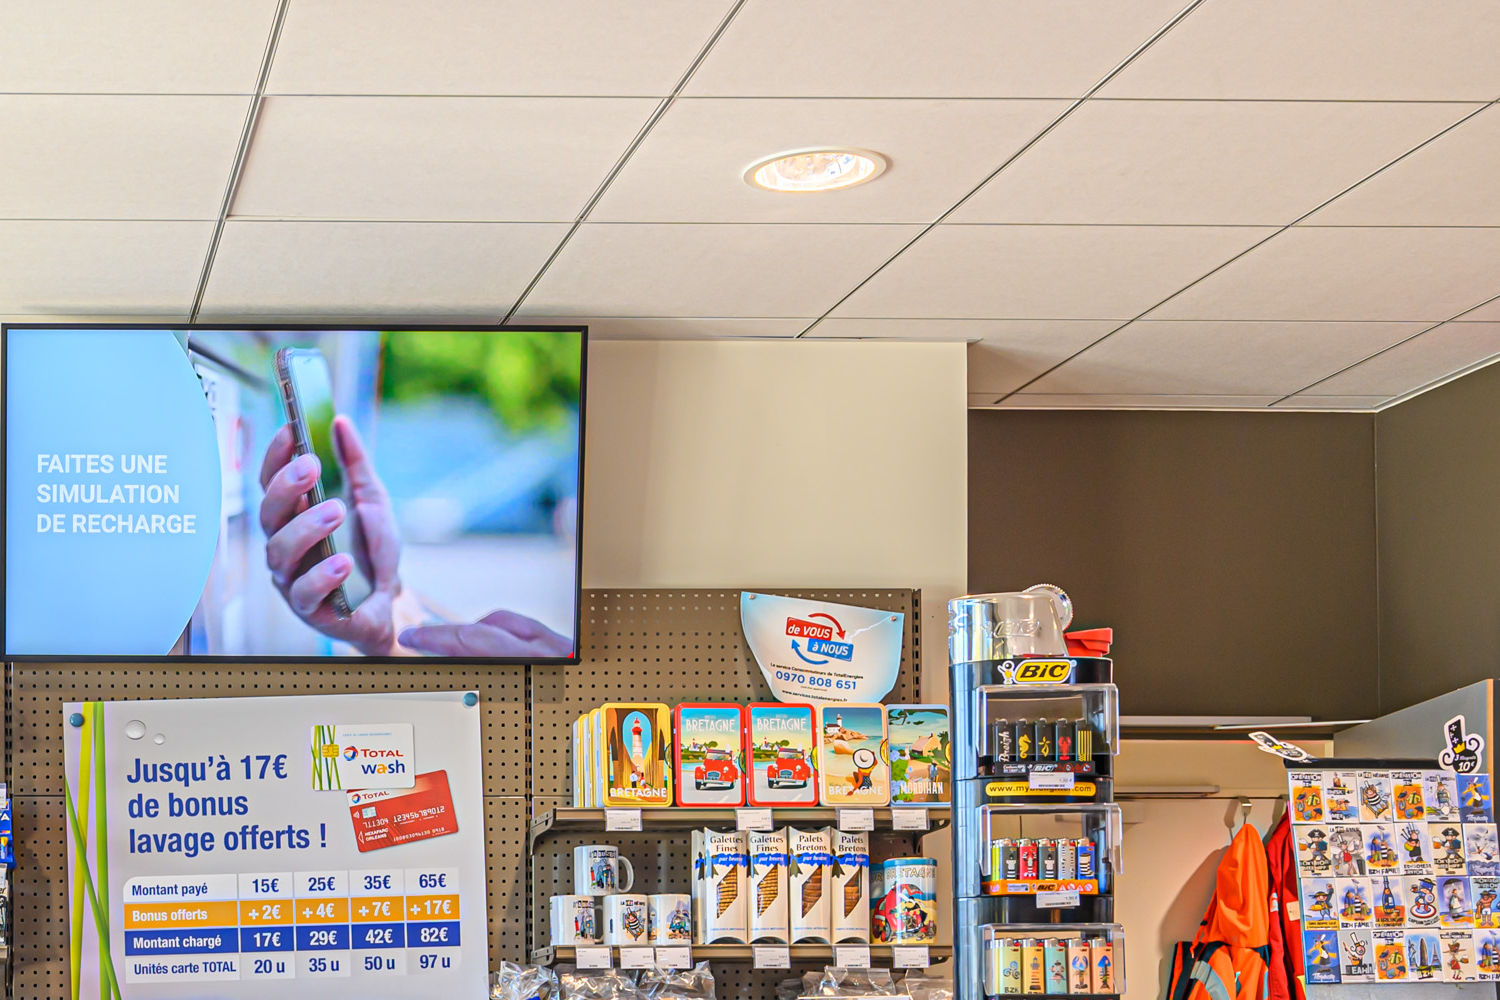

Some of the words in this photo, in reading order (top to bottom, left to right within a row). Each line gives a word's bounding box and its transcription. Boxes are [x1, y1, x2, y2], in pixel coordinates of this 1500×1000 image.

[37, 455, 114, 474] FAITES
[121, 455, 167, 474] UNE
[37, 484, 180, 504] SIMULATION
[37, 514, 66, 533] DE
[71, 514, 196, 534] RECHARGE
[788, 624, 800, 634] de
[803, 626, 830, 638] VOUS
[812, 642, 818, 651] à
[821, 644, 849, 655] NOUS
[776, 671, 805, 683] 0970
[809, 677, 832, 687] 808
[836, 680, 856, 689] 651
[686, 718, 736, 732] BRETAGNE
[757, 718, 807, 731] BRETAGNE
[361, 749, 404, 758] TOTAL
[241, 754, 288, 779] 17€
[361, 760, 405, 774] wash
[610, 788, 667, 798] BRETAGNE
[128, 795, 159, 818] de
[169, 792, 249, 817] bonus
[129, 828, 215, 857] lavage
[224, 824, 310, 851] offerts
[320, 823, 327, 847] !
[710, 836, 743, 845] Galettes
[798, 835, 823, 844] Palets
[716, 844, 738, 853] Fines
[796, 843, 827, 852] Bretons
[132, 883, 178, 896] Montant
[181, 882, 208, 897] payé
[252, 878, 279, 893] 15€
[308, 877, 335, 891] 25€
[364, 875, 391, 890] 35€
[419, 874, 446, 888] 65€
[133, 910, 167, 922] Bonus
[170, 908, 207, 921] offerts
[133, 937, 180, 949] Montant
[182, 934, 222, 951] chargé
[254, 932, 281, 947] 17€
[310, 931, 337, 945] 29€
[365, 929, 393, 944] 42€
[421, 927, 448, 942] 82€
[134, 963, 169, 975] Unités
[171, 963, 200, 974] carte
[203, 960, 236, 973] TOTAL
[254, 960, 275, 973] 20
[277, 962, 284, 973] u
[309, 958, 329, 971] 35
[331, 960, 339, 971] u
[364, 956, 385, 970] 50
[387, 959, 395, 969] u
[420, 955, 440, 968] 97
[442, 957, 450, 968] u
